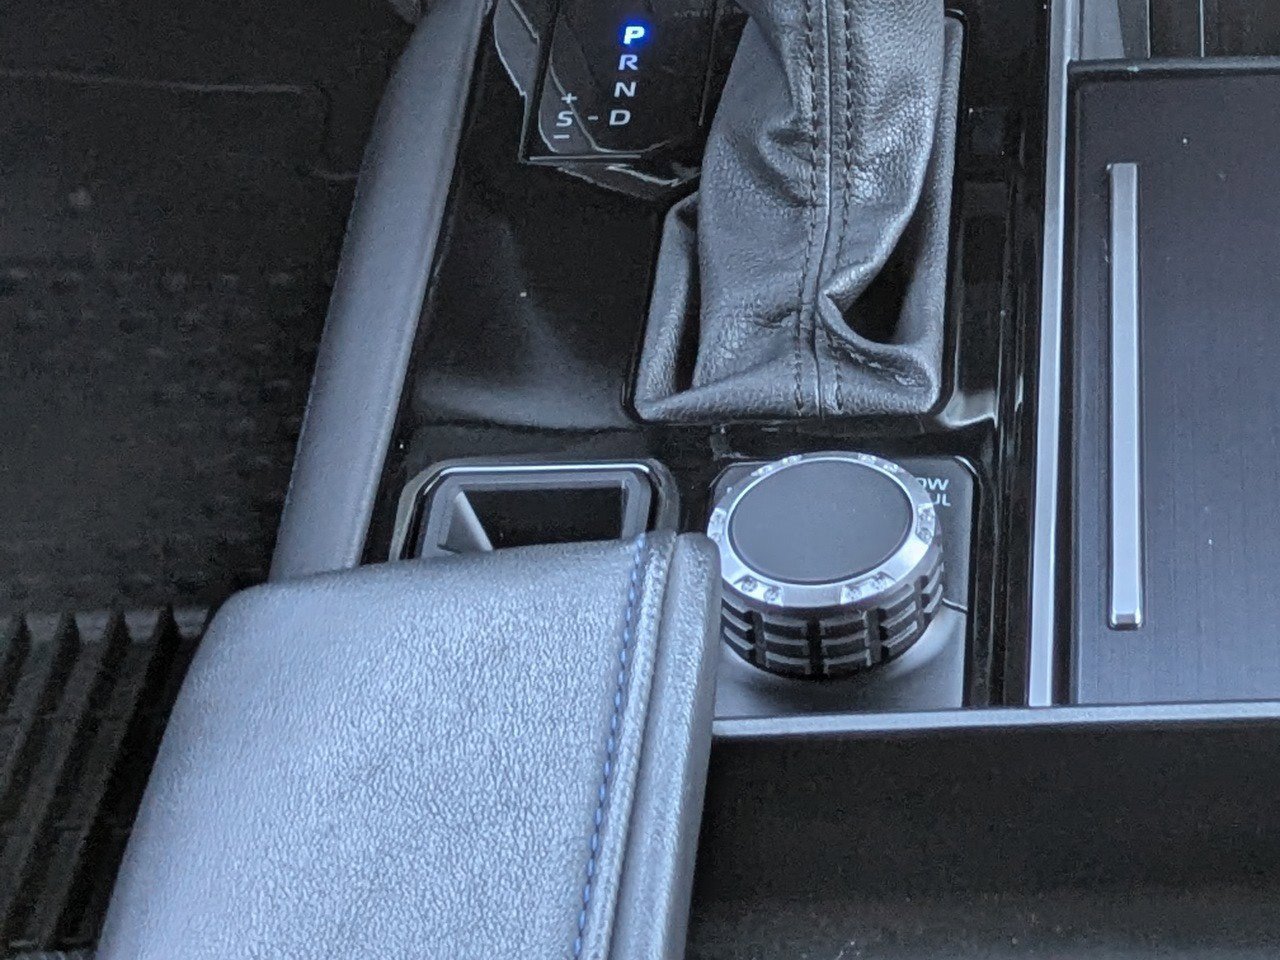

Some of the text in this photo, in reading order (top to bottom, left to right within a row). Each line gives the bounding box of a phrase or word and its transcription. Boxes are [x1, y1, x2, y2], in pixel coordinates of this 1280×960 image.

[623, 26, 645, 45] P
[618, 54, 638, 71] R
[614, 81, 637, 98] N
[556, 109, 632, 127] S D
